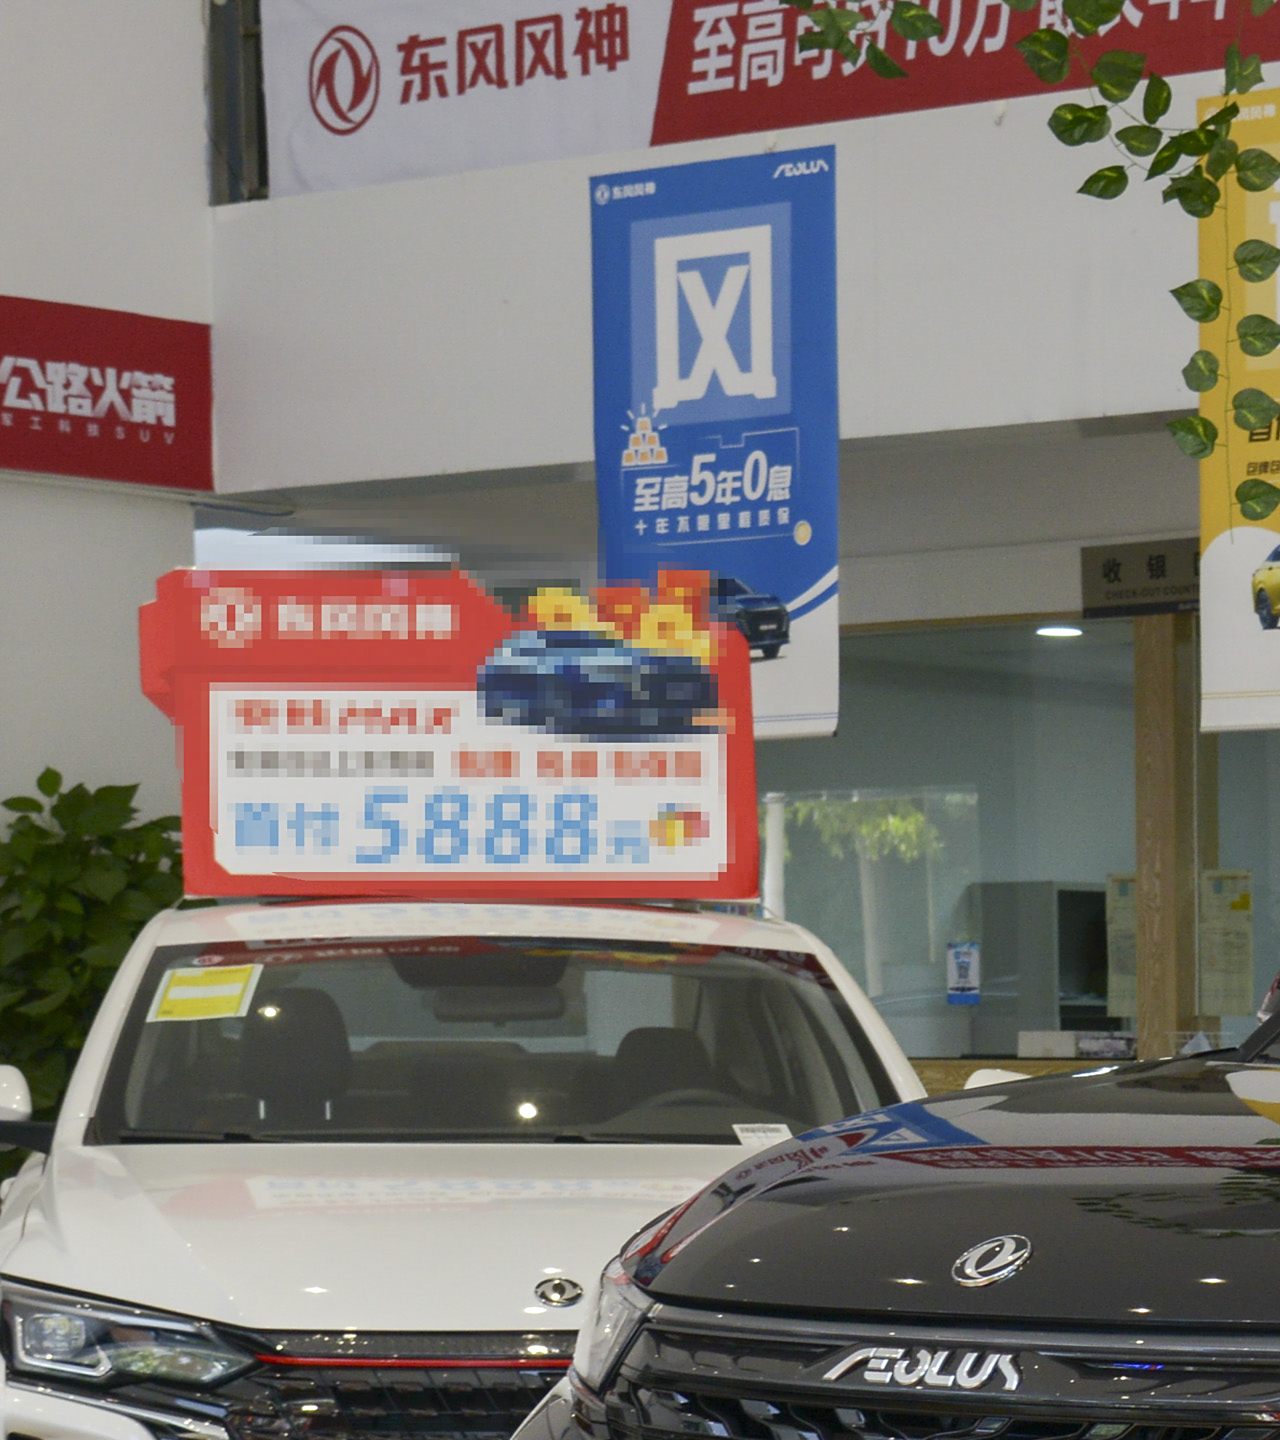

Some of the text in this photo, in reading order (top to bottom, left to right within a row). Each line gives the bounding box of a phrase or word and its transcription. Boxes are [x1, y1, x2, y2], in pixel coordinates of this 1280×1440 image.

[397, 3, 629, 104] 东风风神
[653, 224, 777, 410] 风
[0, 355, 175, 427] 公路火箭
[1103, 554, 1199, 584] 收银
